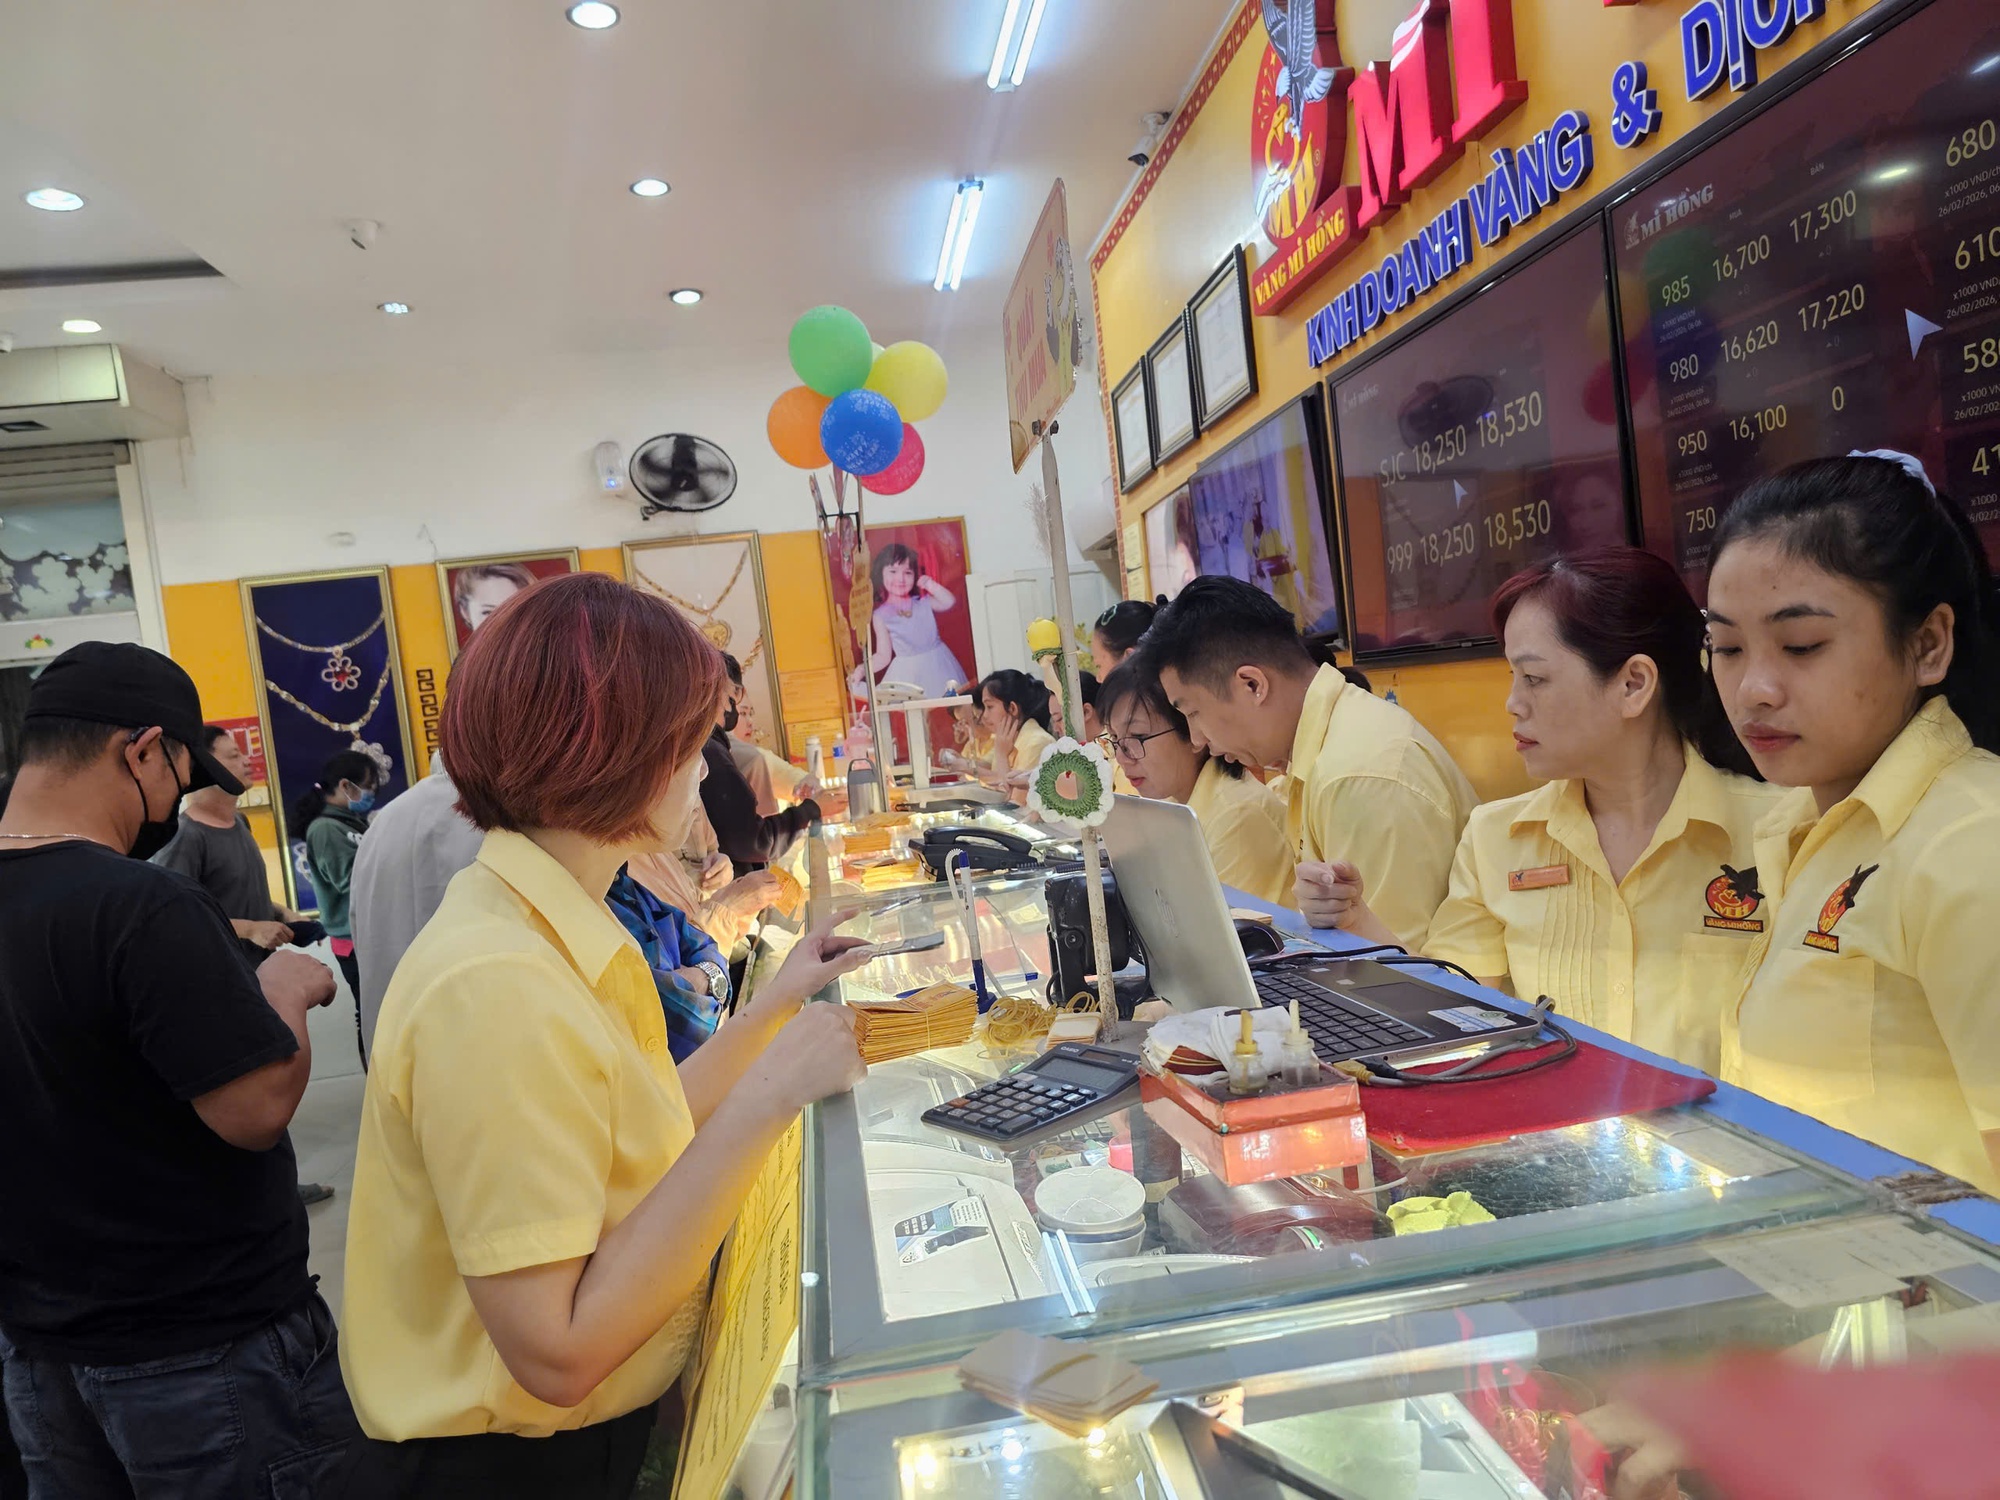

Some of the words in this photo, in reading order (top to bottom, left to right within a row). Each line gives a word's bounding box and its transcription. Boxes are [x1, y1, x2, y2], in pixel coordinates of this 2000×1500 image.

[1945, 119, 1996, 167] 680
[1306, 283, 1364, 369] KINH
[1360, 198, 1470, 332] DOANH
[1467, 110, 1592, 248] VÀNG
[1611, 61, 1661, 149] &
[1680, 0, 1822, 102] DỊ
[1937, 188, 1988, 218] 26/02/2026,
[1944, 180, 1969, 198] x1000
[1254, 262, 1288, 307] VÀNG
[1305, 207, 1346, 264] HỒNG
[1662, 275, 1691, 307] 985
[1712, 234, 1771, 282] 16,700
[1789, 189, 1857, 243] 17,300
[1955, 226, 2000, 270] 610
[1946, 294, 1998, 319] 26/02/2026,
[1953, 283, 1978, 301] x1000
[1669, 353, 1699, 383] 980
[1720, 320, 1779, 363] 16,620
[1797, 283, 1865, 332] 17,220
[1963, 337, 2000, 373] 58
[1961, 387, 1988, 402] x1000
[1379, 451, 1407, 488] SJC
[1411, 424, 1467, 475] 18,250
[1475, 390, 1543, 447] 18,530
[1677, 430, 1708, 457] 950
[1729, 404, 1788, 441] 16,100
[1831, 386, 1845, 412] 0
[1685, 506, 1716, 534] 750
[1970, 493, 1998, 507] x1000
[1386, 541, 1413, 574] 999
[1419, 521, 1475, 568] 18,250
[1484, 499, 1551, 550] 18,530
[1713, 901, 1751, 918] MH
